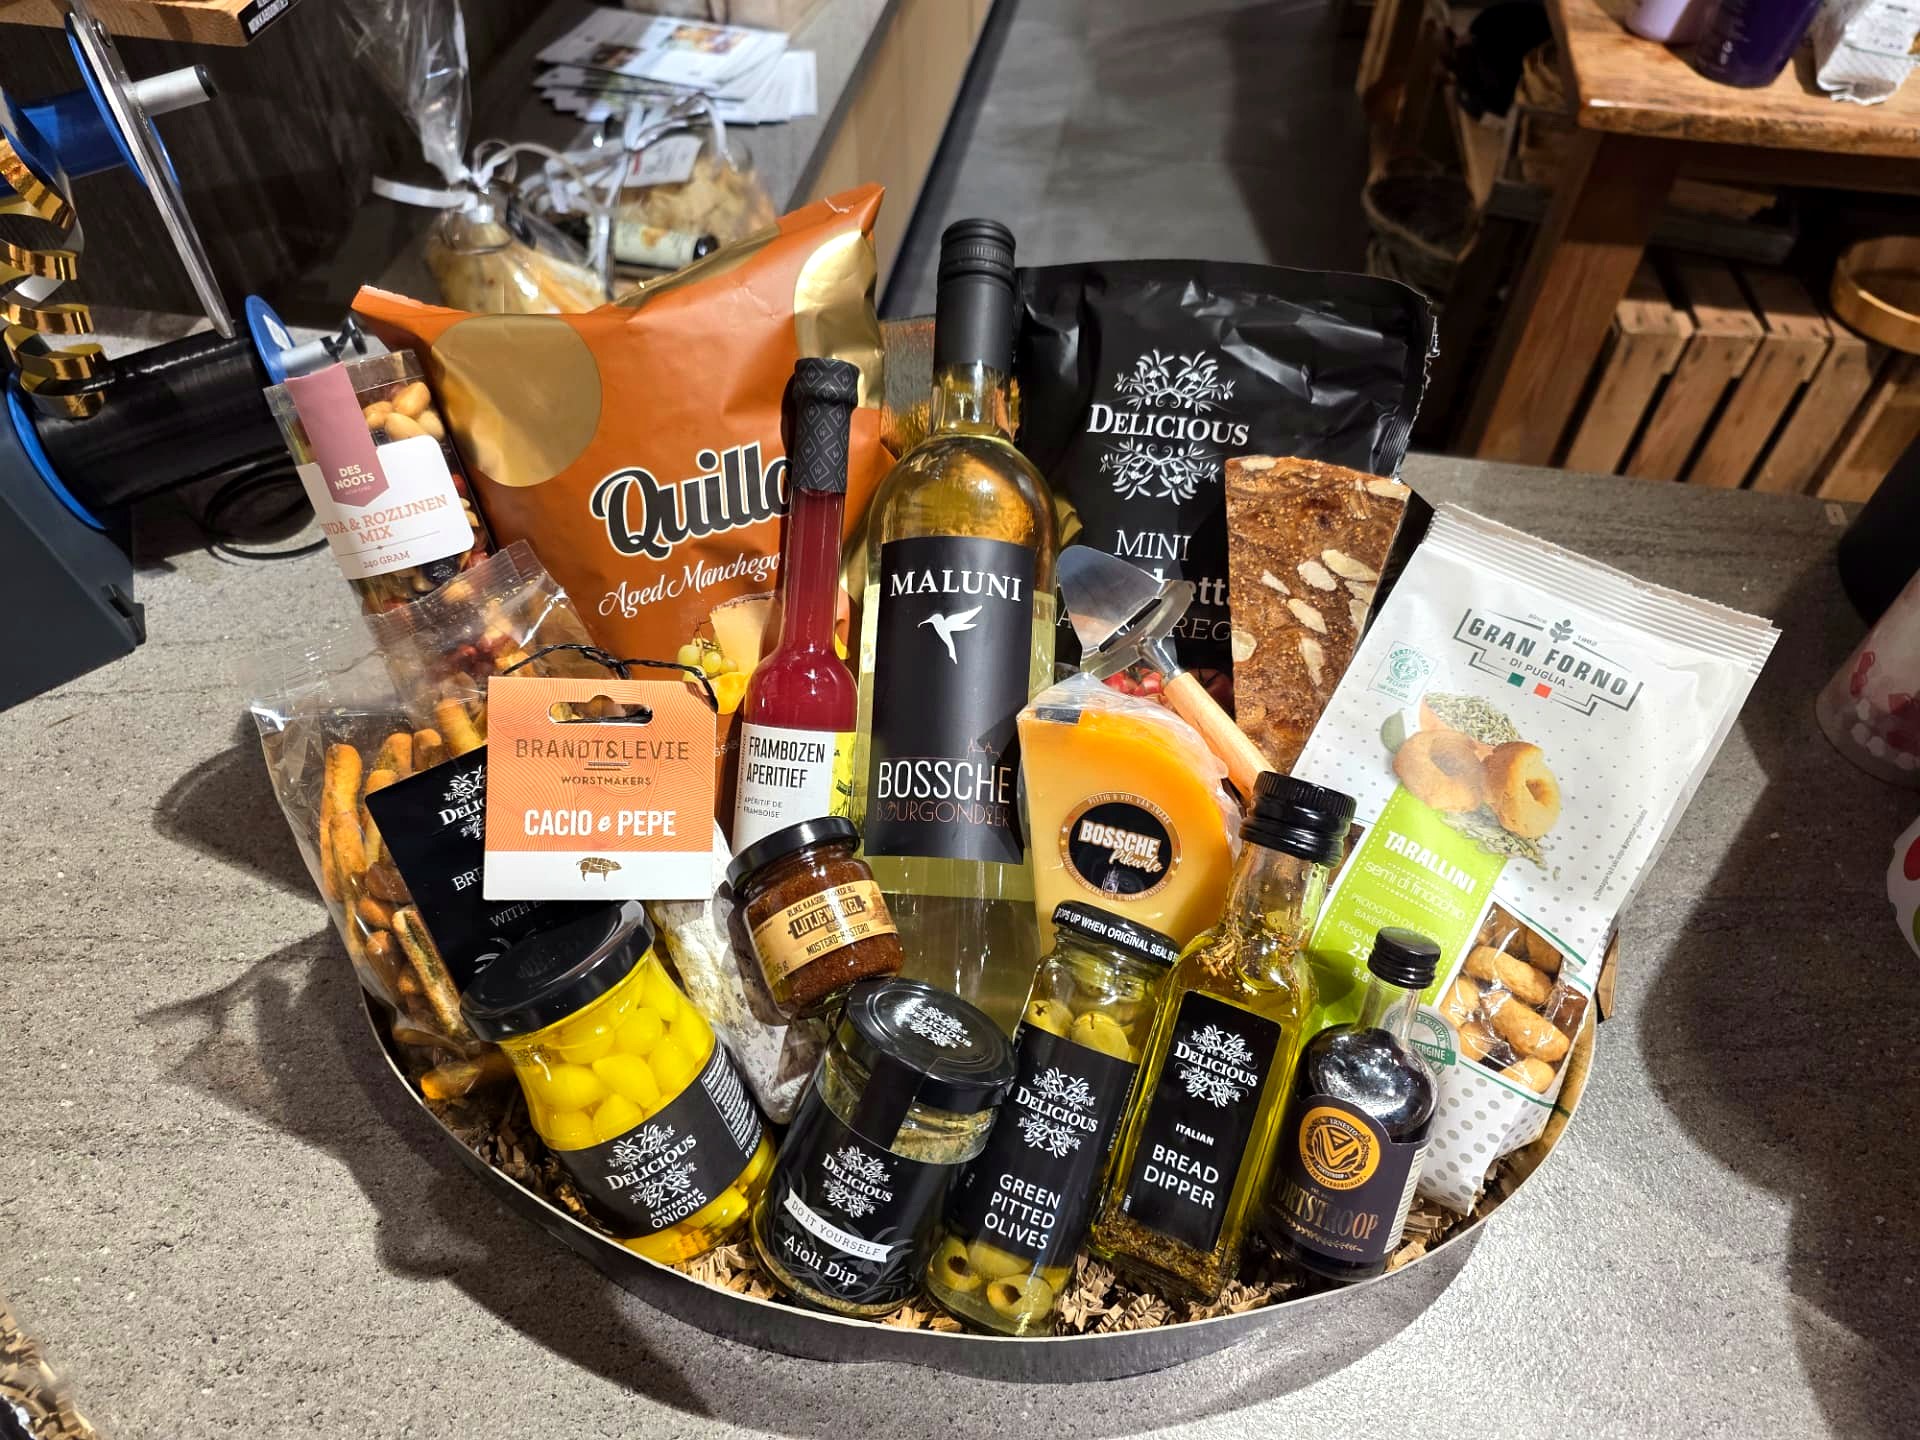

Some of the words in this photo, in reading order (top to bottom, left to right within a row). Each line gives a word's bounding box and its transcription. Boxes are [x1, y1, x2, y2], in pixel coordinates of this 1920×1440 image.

[1086, 403, 1250, 446] DELICIOUS
[334, 472, 375, 491] NOOTS
[338, 464, 362, 478] DES
[350, 517, 361, 531] &
[362, 494, 449, 528] ROZIJNEN
[358, 524, 394, 545] MIX
[1114, 530, 1192, 561] MINI
[379, 550, 411, 567] GRAM
[598, 574, 666, 618] Aged
[667, 552, 781, 598] Manchego
[890, 569, 1022, 602] MALUNI
[1468, 617, 1537, 658] GRAN
[1544, 649, 1629, 696] FORNO
[1509, 658, 1523, 670] DI
[1525, 664, 1567, 688] PUGLIA
[515, 738, 689, 760] BRANDT&LEVIE
[749, 736, 825, 763] FRAMBOZEN
[561, 776, 652, 786] WORSTMAKERS
[746, 762, 808, 789] APERITIEF
[877, 759, 1012, 804] BOSSCHE
[524, 809, 592, 836] CACIO
[598, 816, 611, 832] e
[617, 810, 677, 837] PEPE
[743, 806, 781, 819] FRAMBOISE
[1078, 820, 1161, 858] BOSSCHE
[1108, 847, 1163, 874] Pikante
[1363, 860, 1397, 884] semi
[1397, 871, 1410, 889] di
[1383, 830, 1477, 895] TARALLINI
[490, 903, 529, 928] WITH
[793, 895, 863, 936] LUTJEWKEL
[1070, 912, 1081, 923] UP
[1081, 917, 1106, 935] WHEN
[1107, 924, 1149, 952] ORIGINAL
[1149, 942, 1168, 960] SEAL
[1174, 1041, 1258, 1088] DELICIOUS
[1016, 1086, 1098, 1133] DELICIOUS
[1329, 1118, 1358, 1135] ERNESTO
[1175, 1123, 1215, 1146] ITALIAN
[604, 1134, 697, 1190] DELICIOUS
[822, 1153, 893, 1203] DELICIOUS
[1152, 1143, 1220, 1184] BREAD
[650, 1187, 701, 1219] AMSTERDAM
[999, 1173, 1061, 1210] GREEN
[1143, 1165, 1215, 1209] DIPPER
[652, 1192, 707, 1228] ONIONS
[791, 1199, 804, 1218] DO
[805, 1212, 817, 1228] IT
[818, 1223, 881, 1257] YOURSELF
[990, 1191, 1056, 1229] PITTED
[984, 1213, 1049, 1249] OLIVES
[783, 1233, 826, 1272] Aioli
[825, 1257, 858, 1286] Dip
